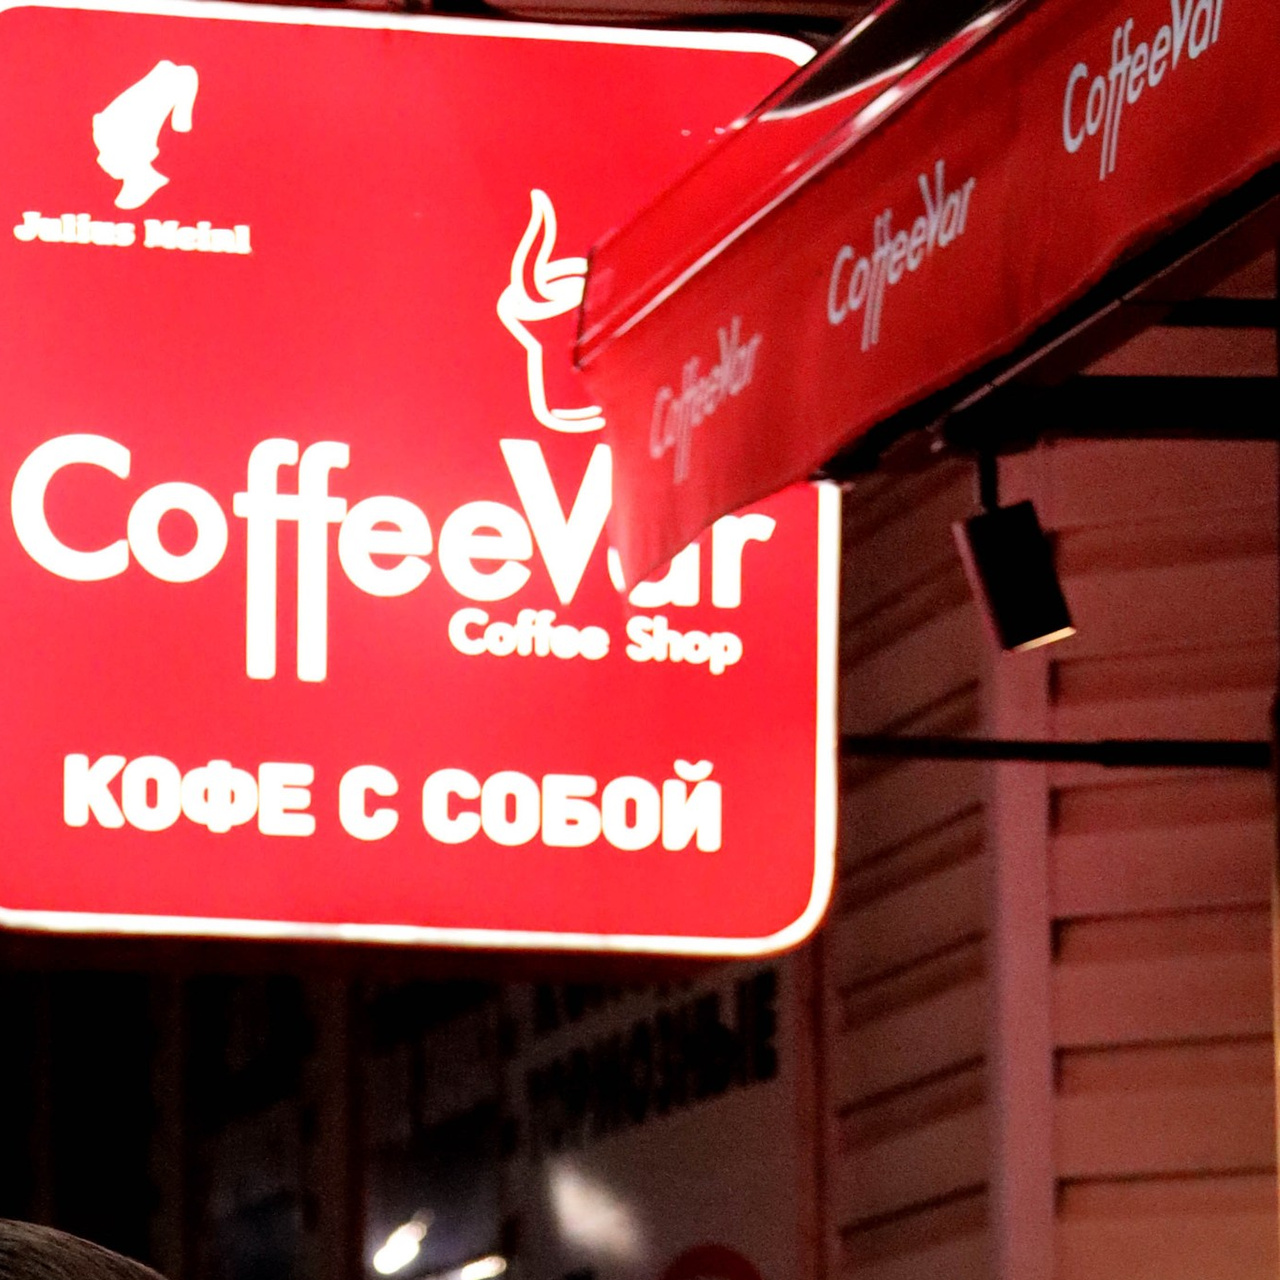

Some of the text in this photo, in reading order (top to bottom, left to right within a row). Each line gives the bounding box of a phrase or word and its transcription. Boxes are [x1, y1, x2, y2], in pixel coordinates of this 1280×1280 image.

[14, 211, 136, 246] Julius
[828, 159, 976, 352] CoffeeVar
[448, 607, 743, 675] Coffee Shop
[64, 753, 722, 852] КОФЕ С СОБОЙ
